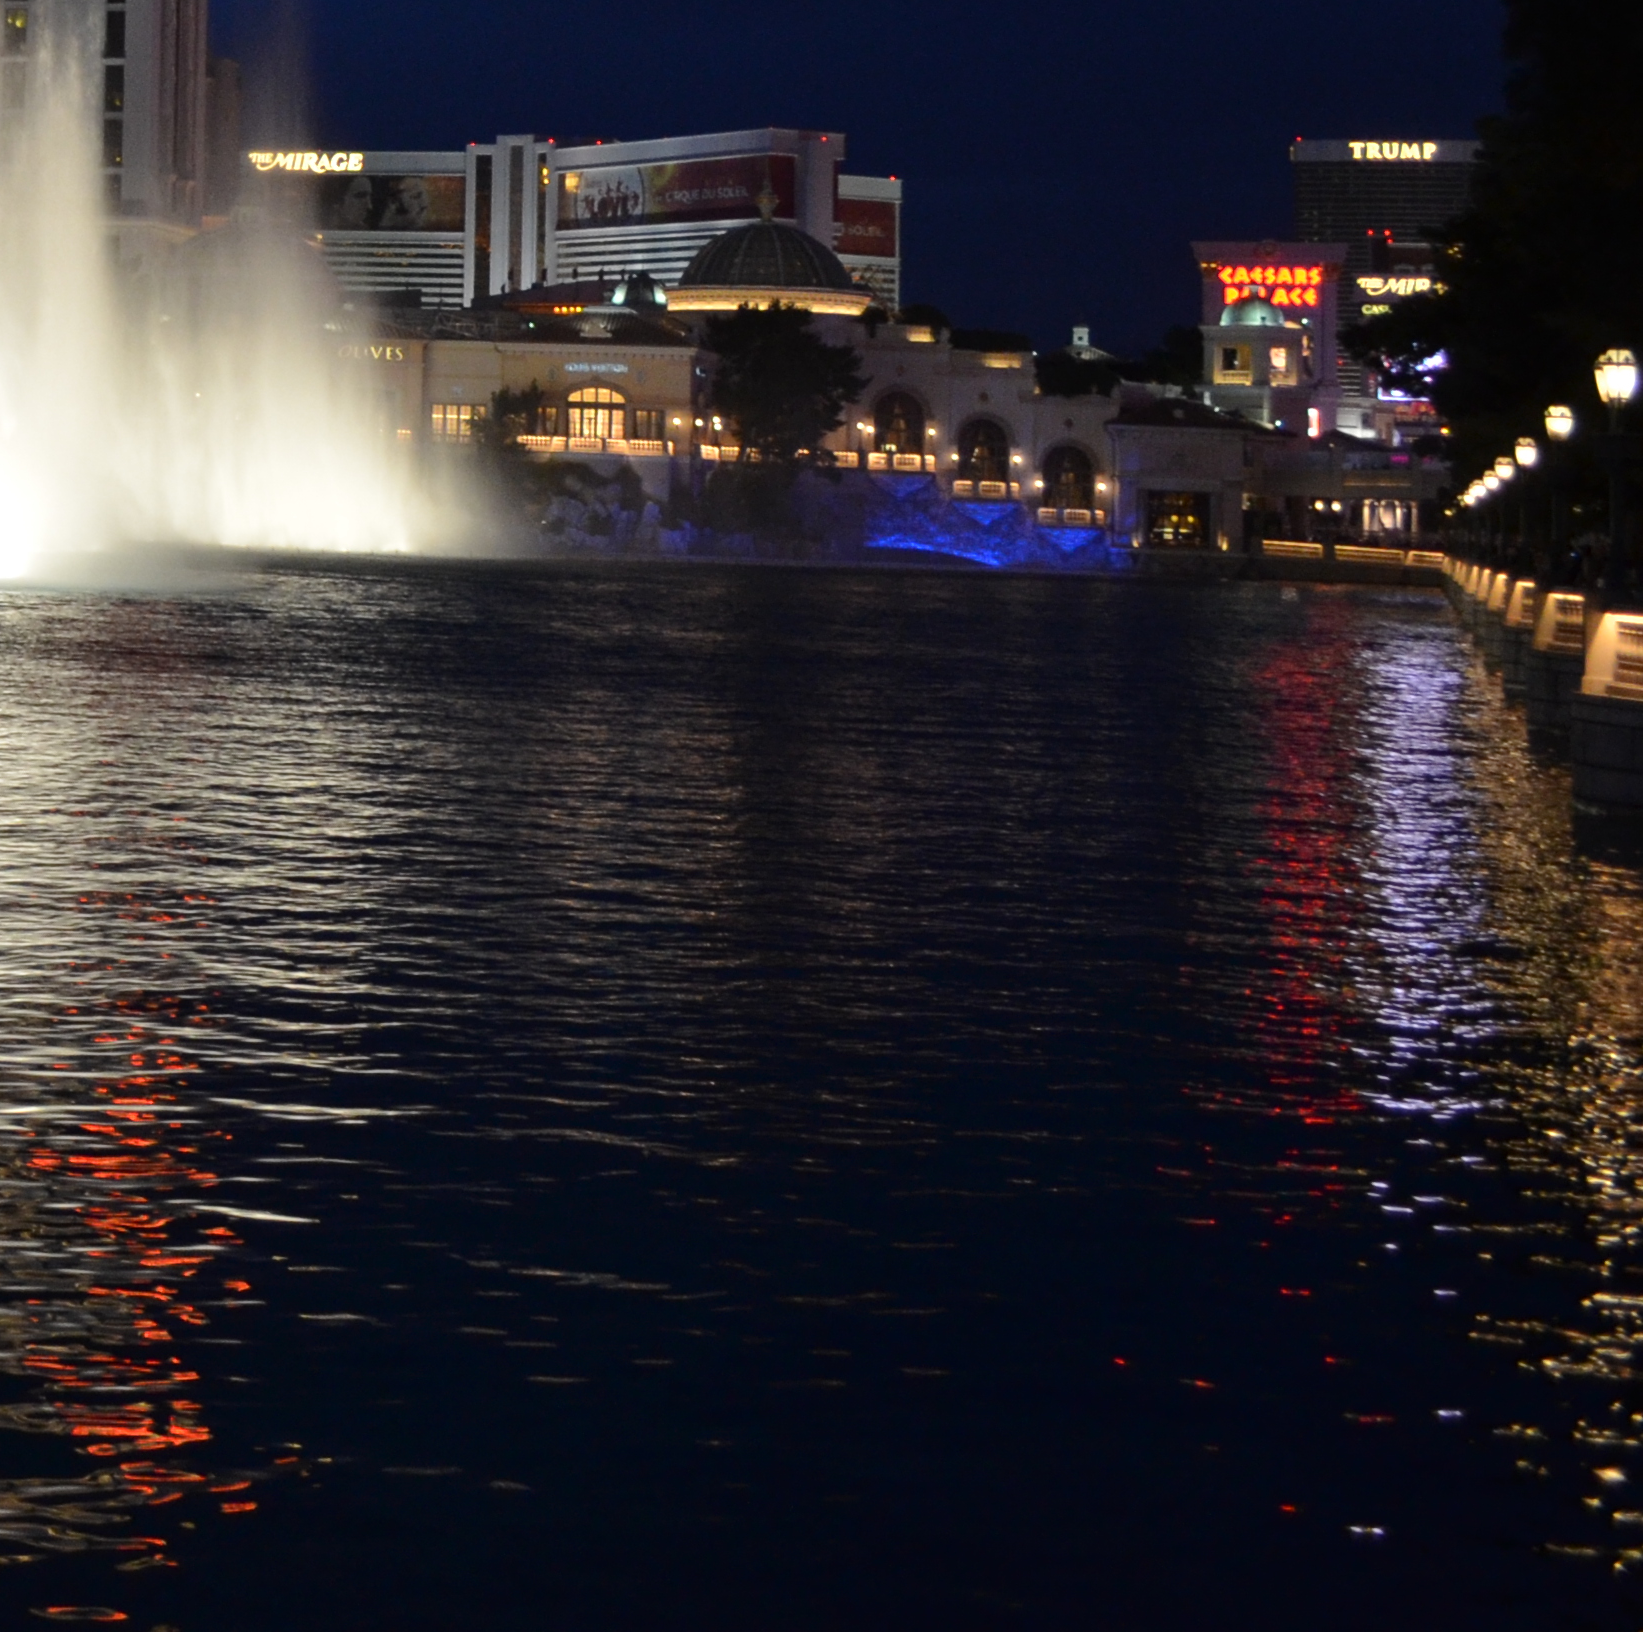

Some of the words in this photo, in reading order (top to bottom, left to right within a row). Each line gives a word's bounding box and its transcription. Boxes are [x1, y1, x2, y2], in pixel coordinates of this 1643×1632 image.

[248, 152, 274, 164] THE
[1348, 141, 1437, 160] TRUMP
[256, 152, 364, 174] MIRAGE
[1218, 265, 1322, 285] CAESARS
[1223, 285, 1318, 306] PACE
[1366, 277, 1449, 296] MIR
[338, 345, 404, 361] OLIVES
